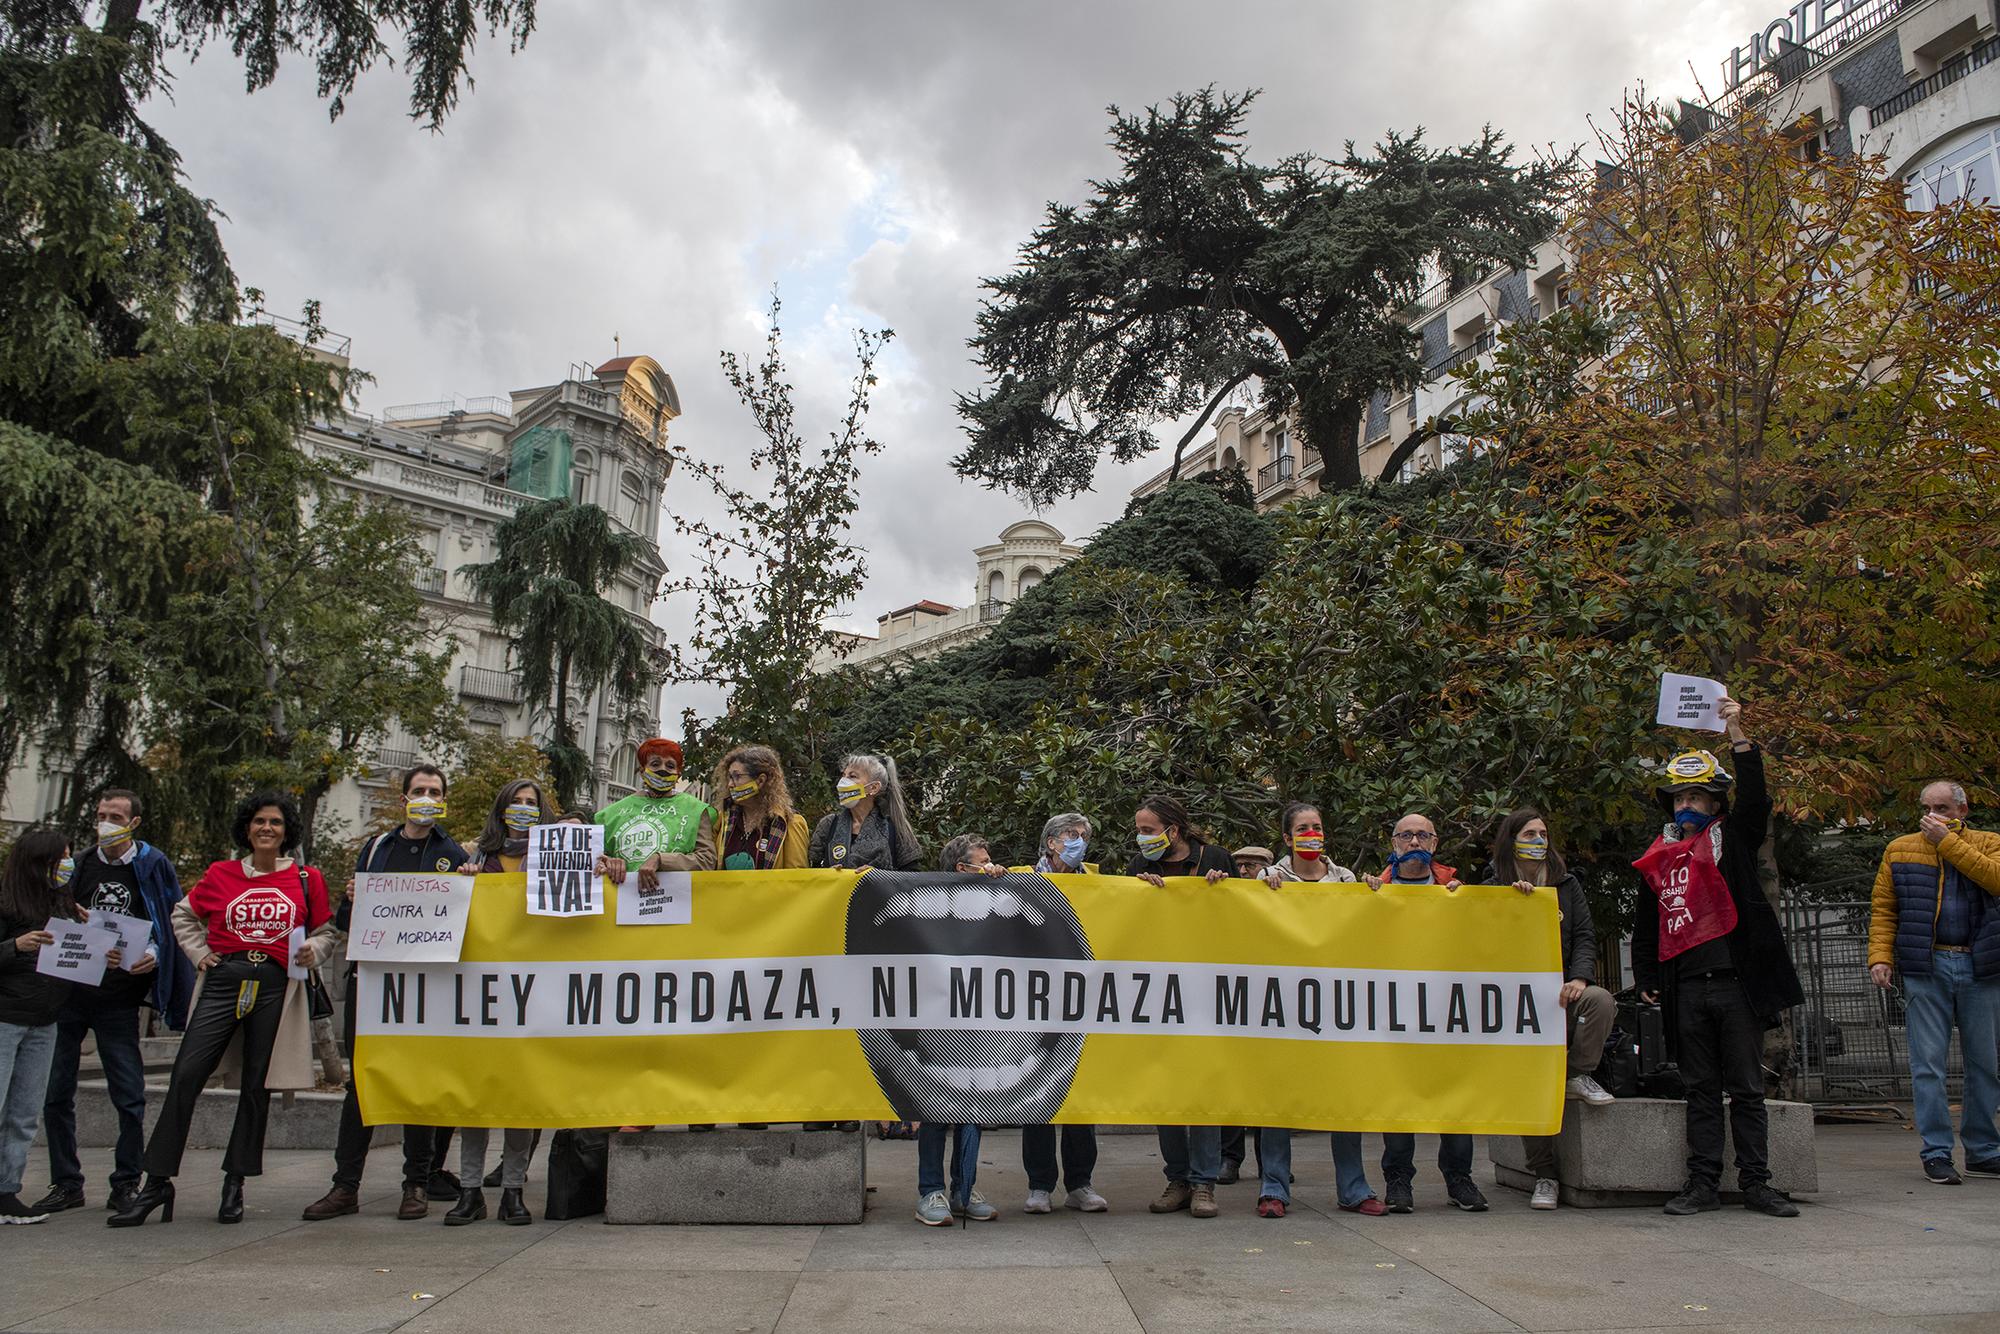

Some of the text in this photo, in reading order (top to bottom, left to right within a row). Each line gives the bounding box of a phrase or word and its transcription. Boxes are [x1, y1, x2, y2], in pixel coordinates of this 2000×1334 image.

[641, 803, 677, 816] CASA
[539, 827, 593, 851] LEY DE
[624, 831, 653, 846] STOP
[539, 851, 593, 871] VIVIENDA
[538, 870, 593, 912] ¡YA!
[234, 902, 289, 921] STOP
[372, 904, 448, 918] CONTRA LA
[235, 920, 287, 930] DESAHUCIOS
[362, 929, 452, 949] LEY MORDAZA
[382, 966, 1541, 1035] NI LEY MORDAZA, NI MORDAZA MAQUILLADA
